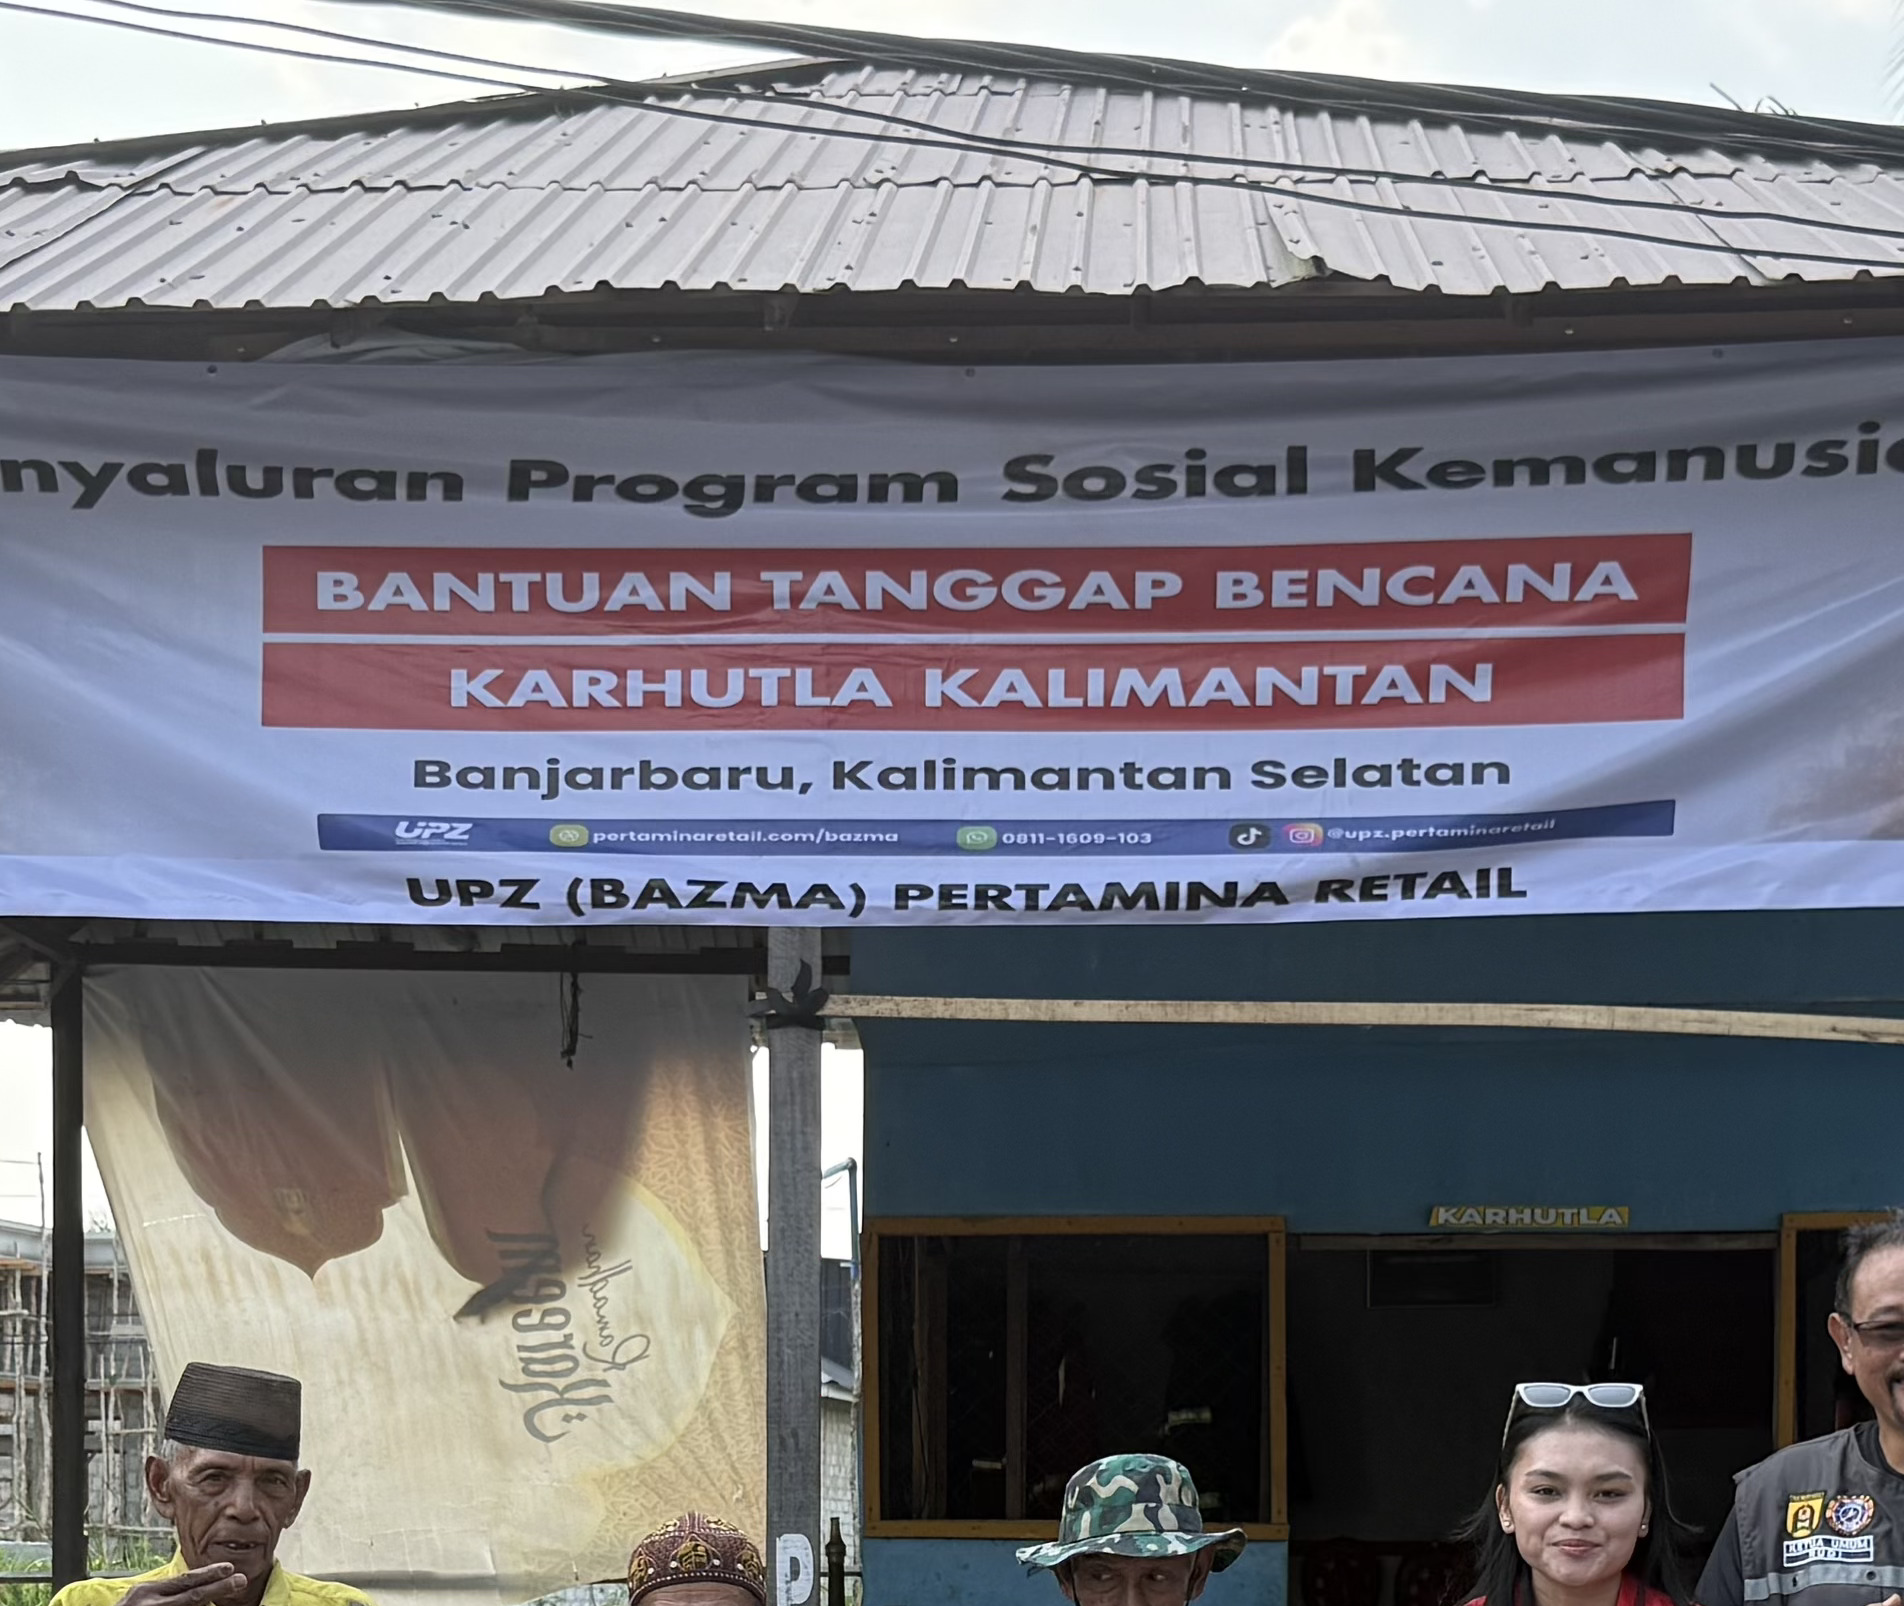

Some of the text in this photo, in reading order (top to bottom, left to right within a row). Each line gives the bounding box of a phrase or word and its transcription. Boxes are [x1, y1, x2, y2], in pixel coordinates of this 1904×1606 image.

[507, 458, 959, 518] Program
[1000, 444, 1309, 503] Sosial
[315, 561, 1639, 613] BANTUAN TANGGAP BENCANA
[449, 663, 1493, 708] KARHUTLA KALIMANTAN
[413, 757, 1511, 801] Banjarbaru, Kalimantan Selatan
[394, 818, 1556, 846] UPZ pertaminaretail.com/bazma 0811-1609-103 @upz.pertaminaretail
[405, 866, 1528, 918] UPZ (BAZMA) PERTAMINA RETAIL
[1437, 1207, 1623, 1225] KARHUTLA
